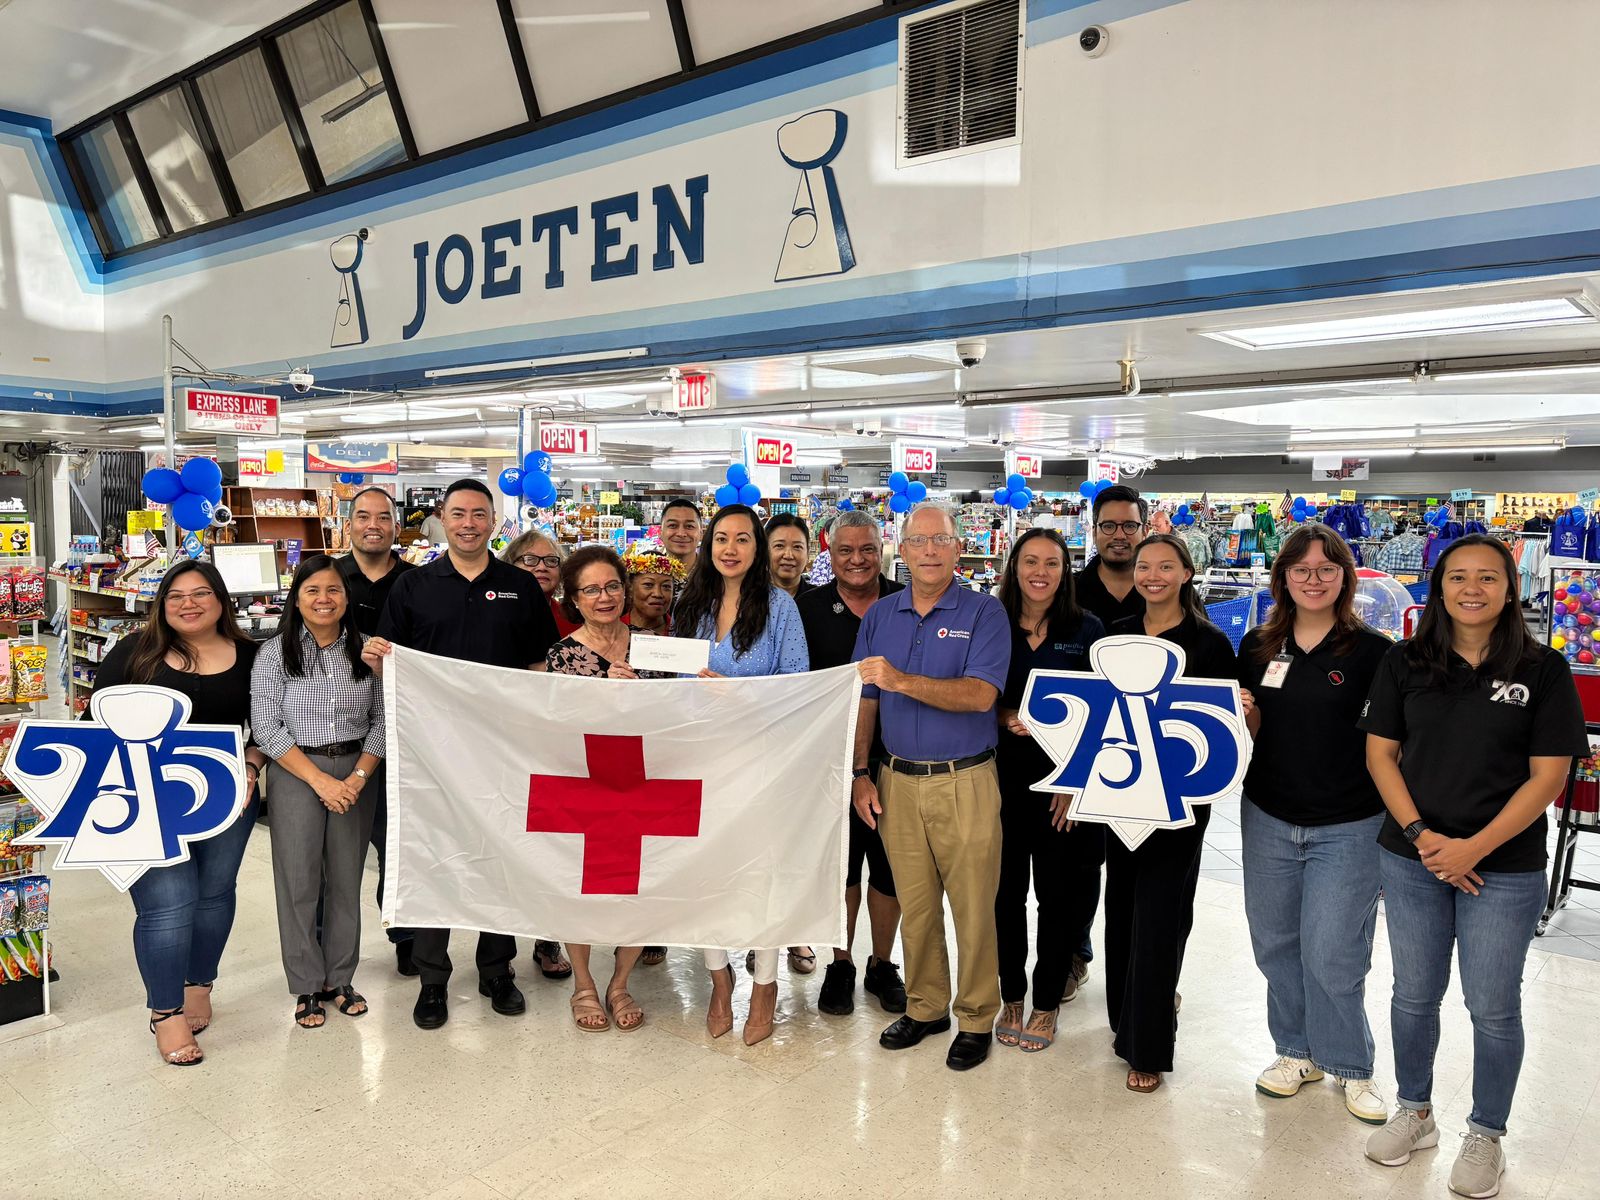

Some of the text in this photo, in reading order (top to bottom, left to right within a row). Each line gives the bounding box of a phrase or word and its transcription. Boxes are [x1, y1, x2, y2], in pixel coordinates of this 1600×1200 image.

[402, 173, 710, 340] JOETEN
[678, 375, 706, 408] EXIT
[196, 393, 268, 415] EXPRESS LANE
[234, 422, 262, 431] ONLY
[543, 428, 588, 452] OPEN 1
[336, 449, 371, 457] DELI
[758, 443, 793, 465] OPEN 2
[907, 452, 933, 470] OPEN 3
[1031, 459, 1039, 476] 4
[1110, 466, 1117, 481] 5
[1326, 469, 1355, 478] SALE
[1490, 679, 1530, 704] 70
